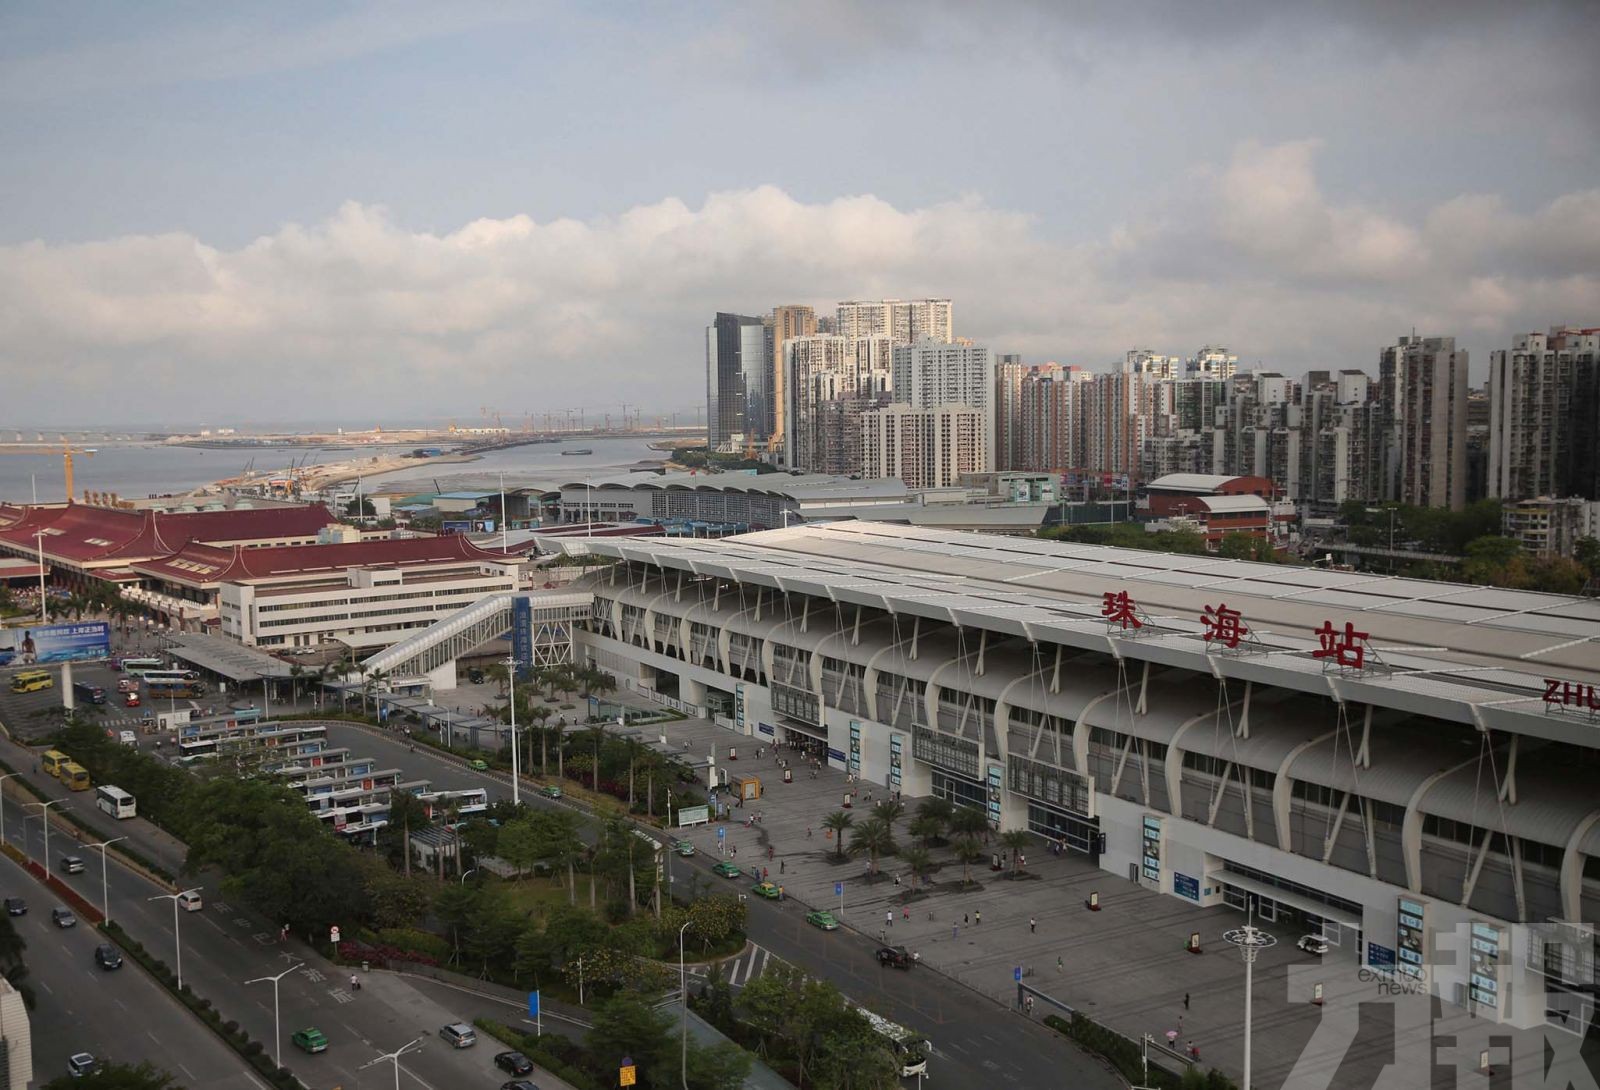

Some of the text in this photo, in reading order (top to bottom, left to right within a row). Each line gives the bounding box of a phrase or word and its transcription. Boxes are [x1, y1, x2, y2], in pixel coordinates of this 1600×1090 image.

[1101, 590, 1369, 669] 珠海站
[1542, 679, 1600, 709] ZHU
